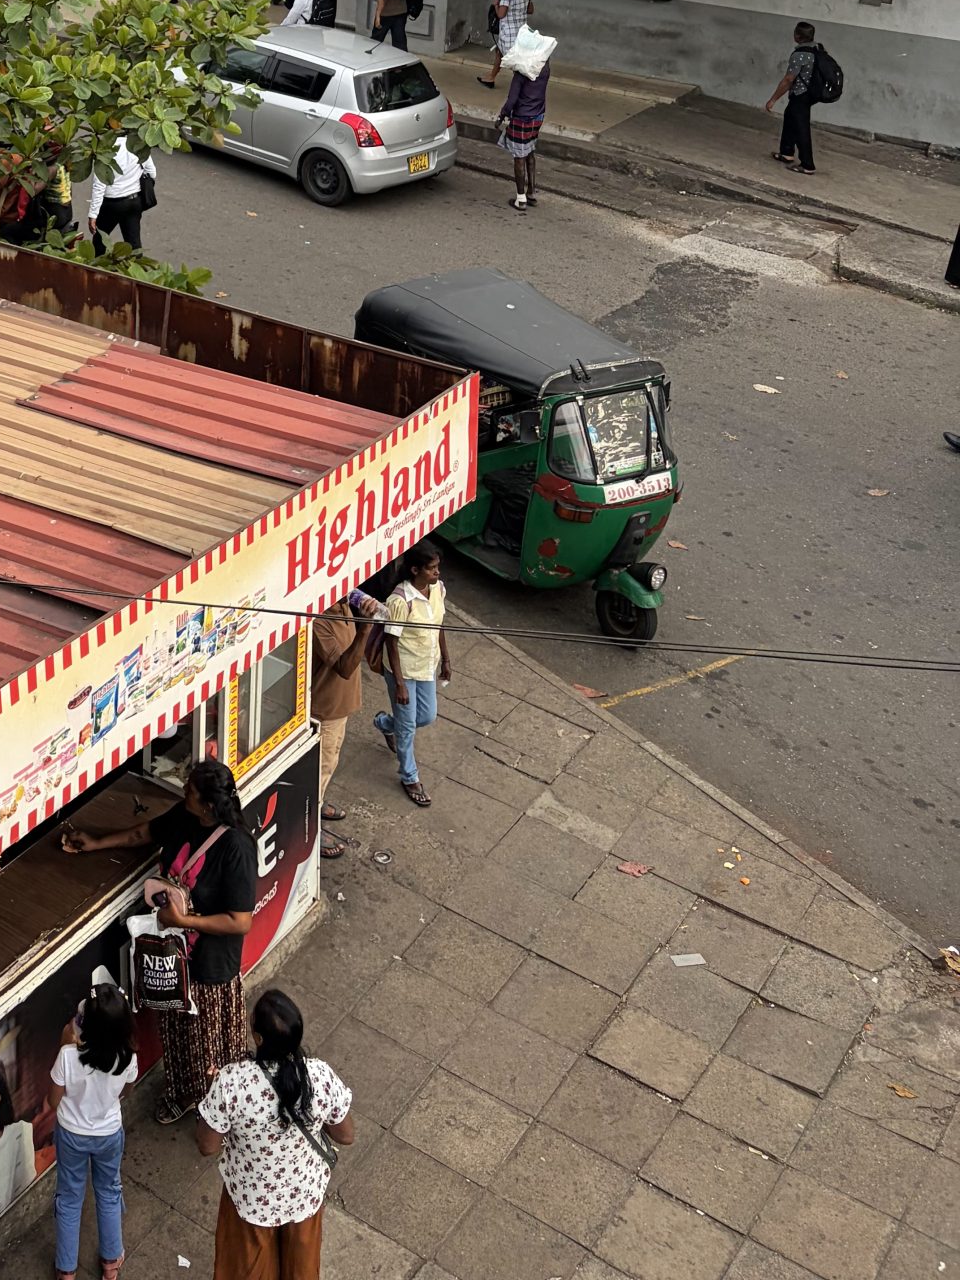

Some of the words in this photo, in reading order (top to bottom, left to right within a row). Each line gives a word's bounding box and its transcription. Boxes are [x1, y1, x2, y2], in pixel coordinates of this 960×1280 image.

[607, 477, 672, 502] 200-3513
[284, 421, 453, 598] Highland
[383, 504, 423, 539] Refreshingly
[142, 953, 177, 971] NEW
[143, 969, 178, 979] COLOMBO
[143, 976, 178, 987] FASHION
